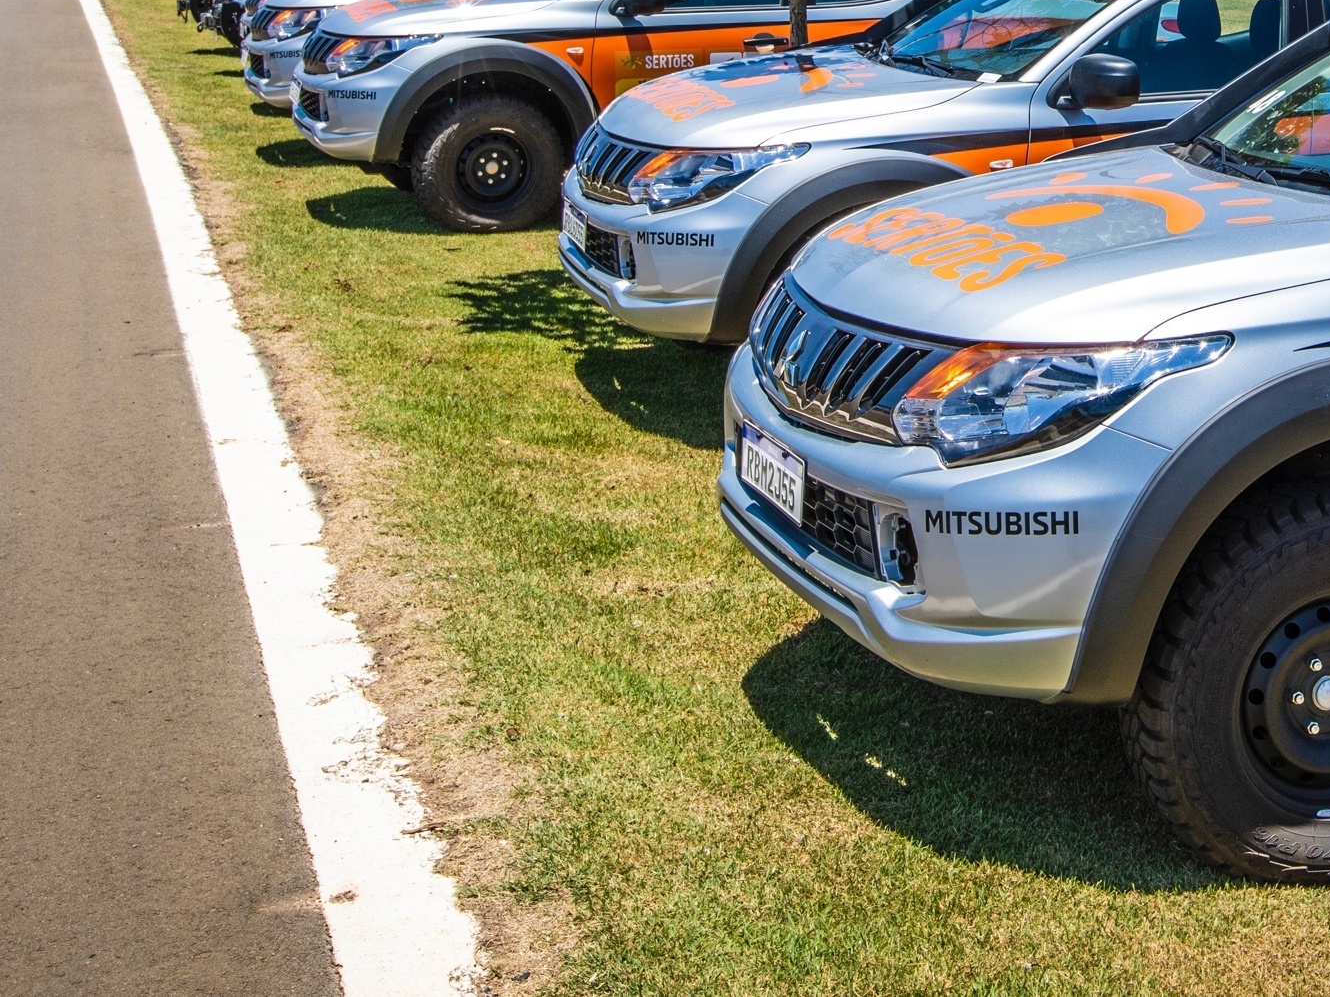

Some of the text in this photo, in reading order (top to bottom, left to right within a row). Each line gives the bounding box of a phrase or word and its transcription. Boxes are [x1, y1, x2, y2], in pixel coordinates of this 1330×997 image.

[270, 50, 303, 59] MITSUBIS
[328, 90, 376, 100] MITSUBISHI
[637, 231, 715, 247] MITSUBISHI
[925, 510, 1079, 535] MITSUBISHI
